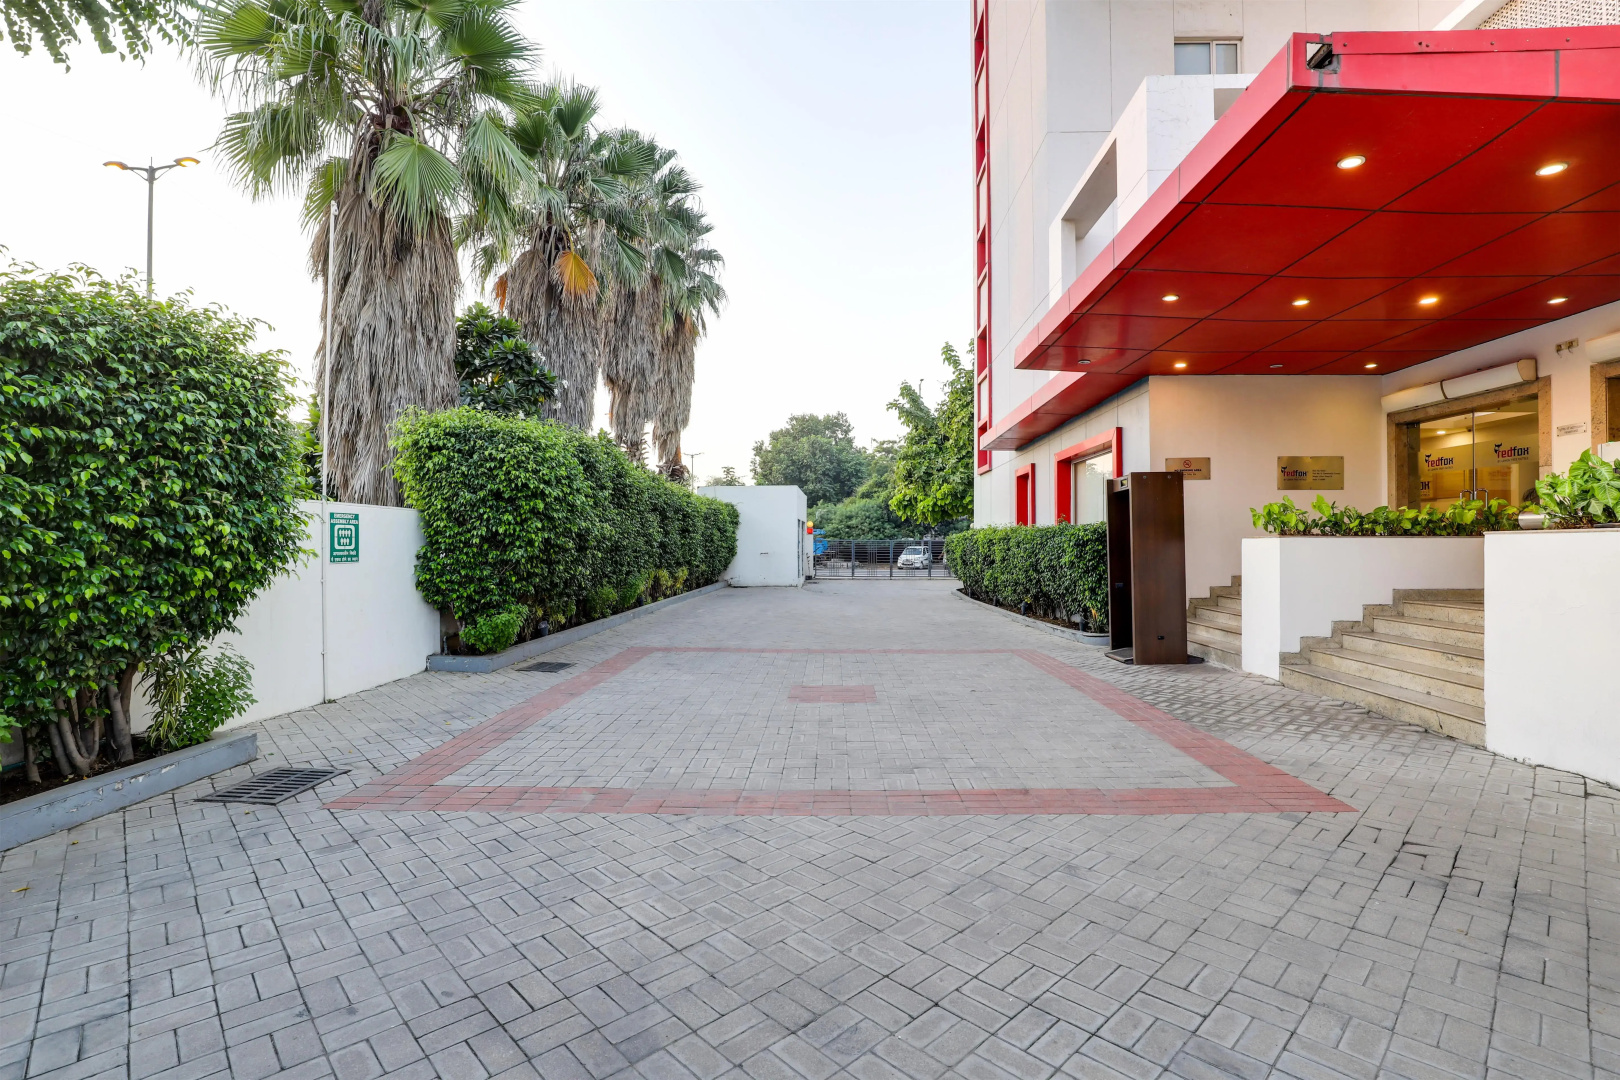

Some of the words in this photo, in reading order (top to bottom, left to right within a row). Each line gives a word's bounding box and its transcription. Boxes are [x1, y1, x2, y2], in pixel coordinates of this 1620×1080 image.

[1497, 446, 1529, 459] redfox
[1427, 457, 1454, 468] redfox
[1283, 469, 1307, 477] redfox
